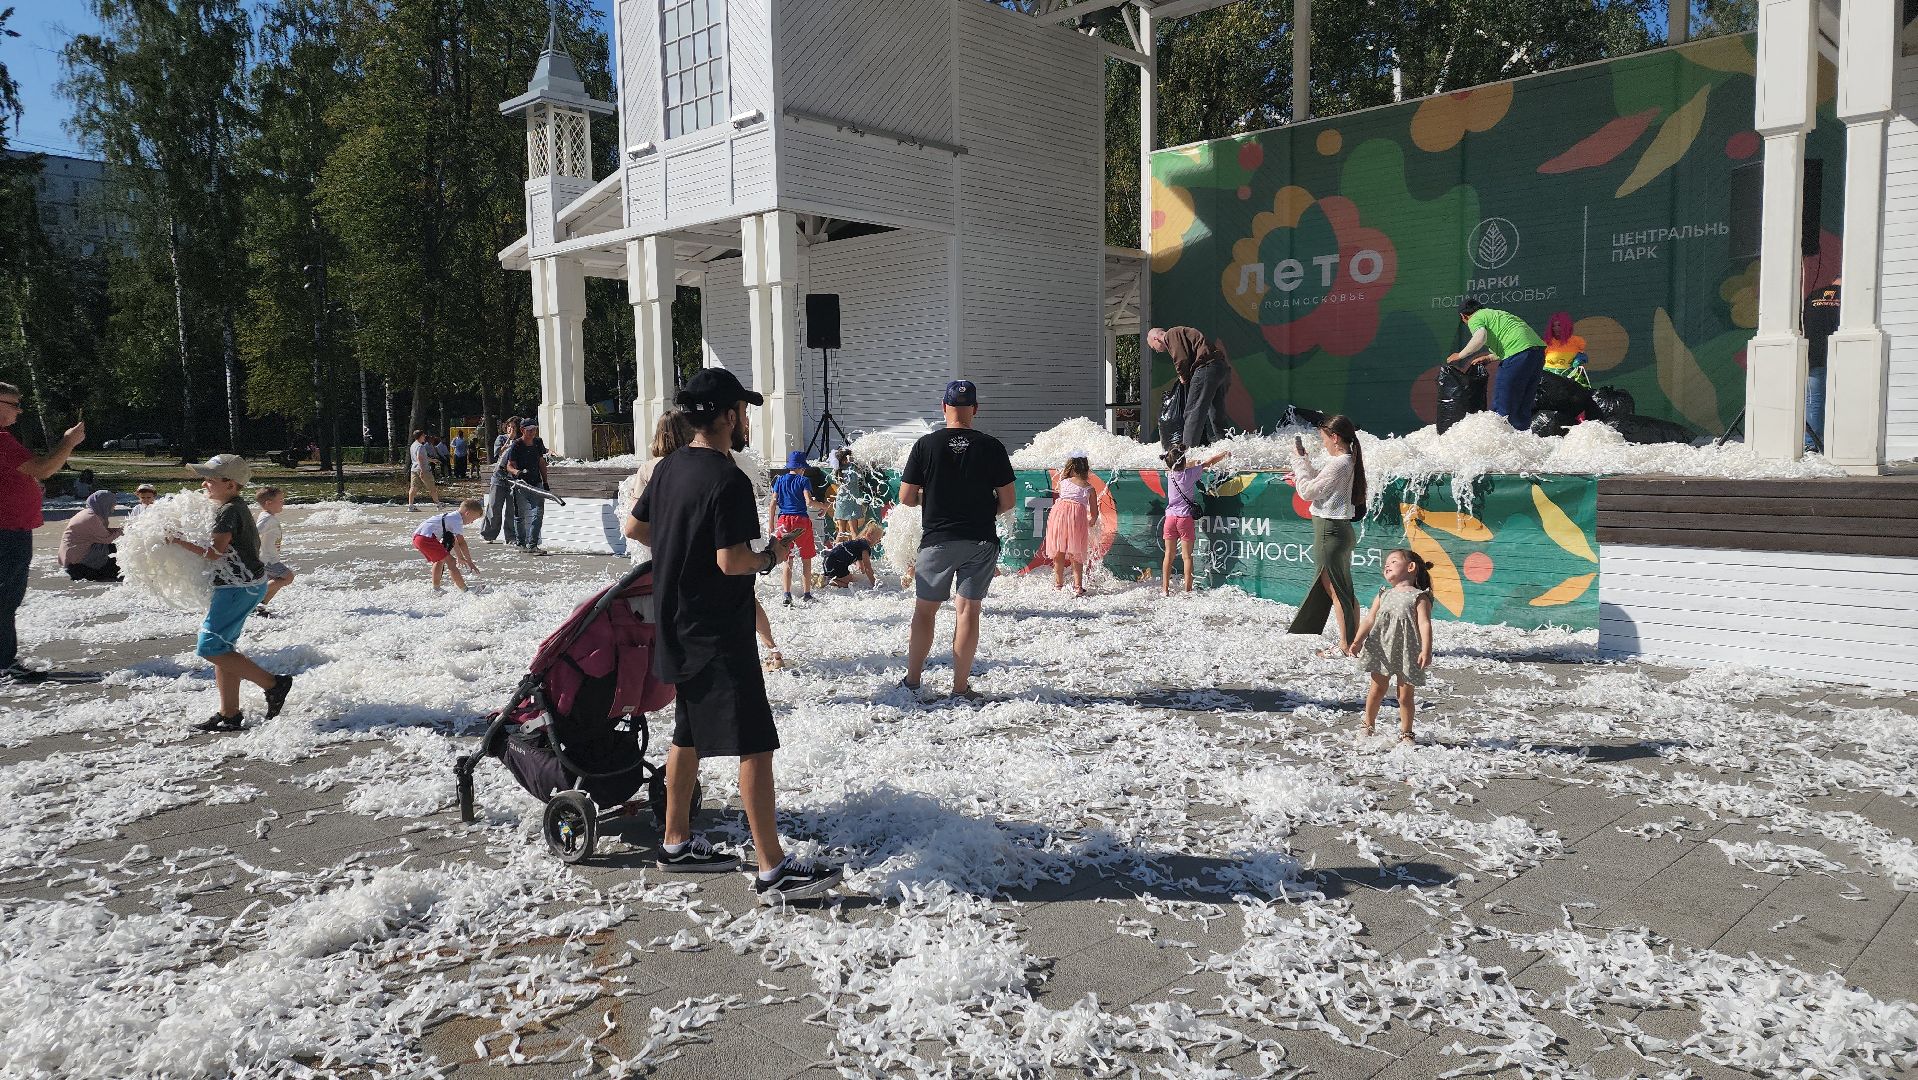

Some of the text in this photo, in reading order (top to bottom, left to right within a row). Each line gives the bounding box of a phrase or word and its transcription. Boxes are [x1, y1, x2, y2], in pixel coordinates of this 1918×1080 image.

[1611, 245, 1658, 262] ПАРК
[1236, 250, 1383, 295] лето
[1466, 274, 1519, 291] ПАРКИ
[1250, 292, 1365, 310] В ПОДМОСКОВЬЕ
[1198, 515, 1270, 537] ПАРКИ
[1197, 538, 1382, 568] ПОДМОСКЬЯ
